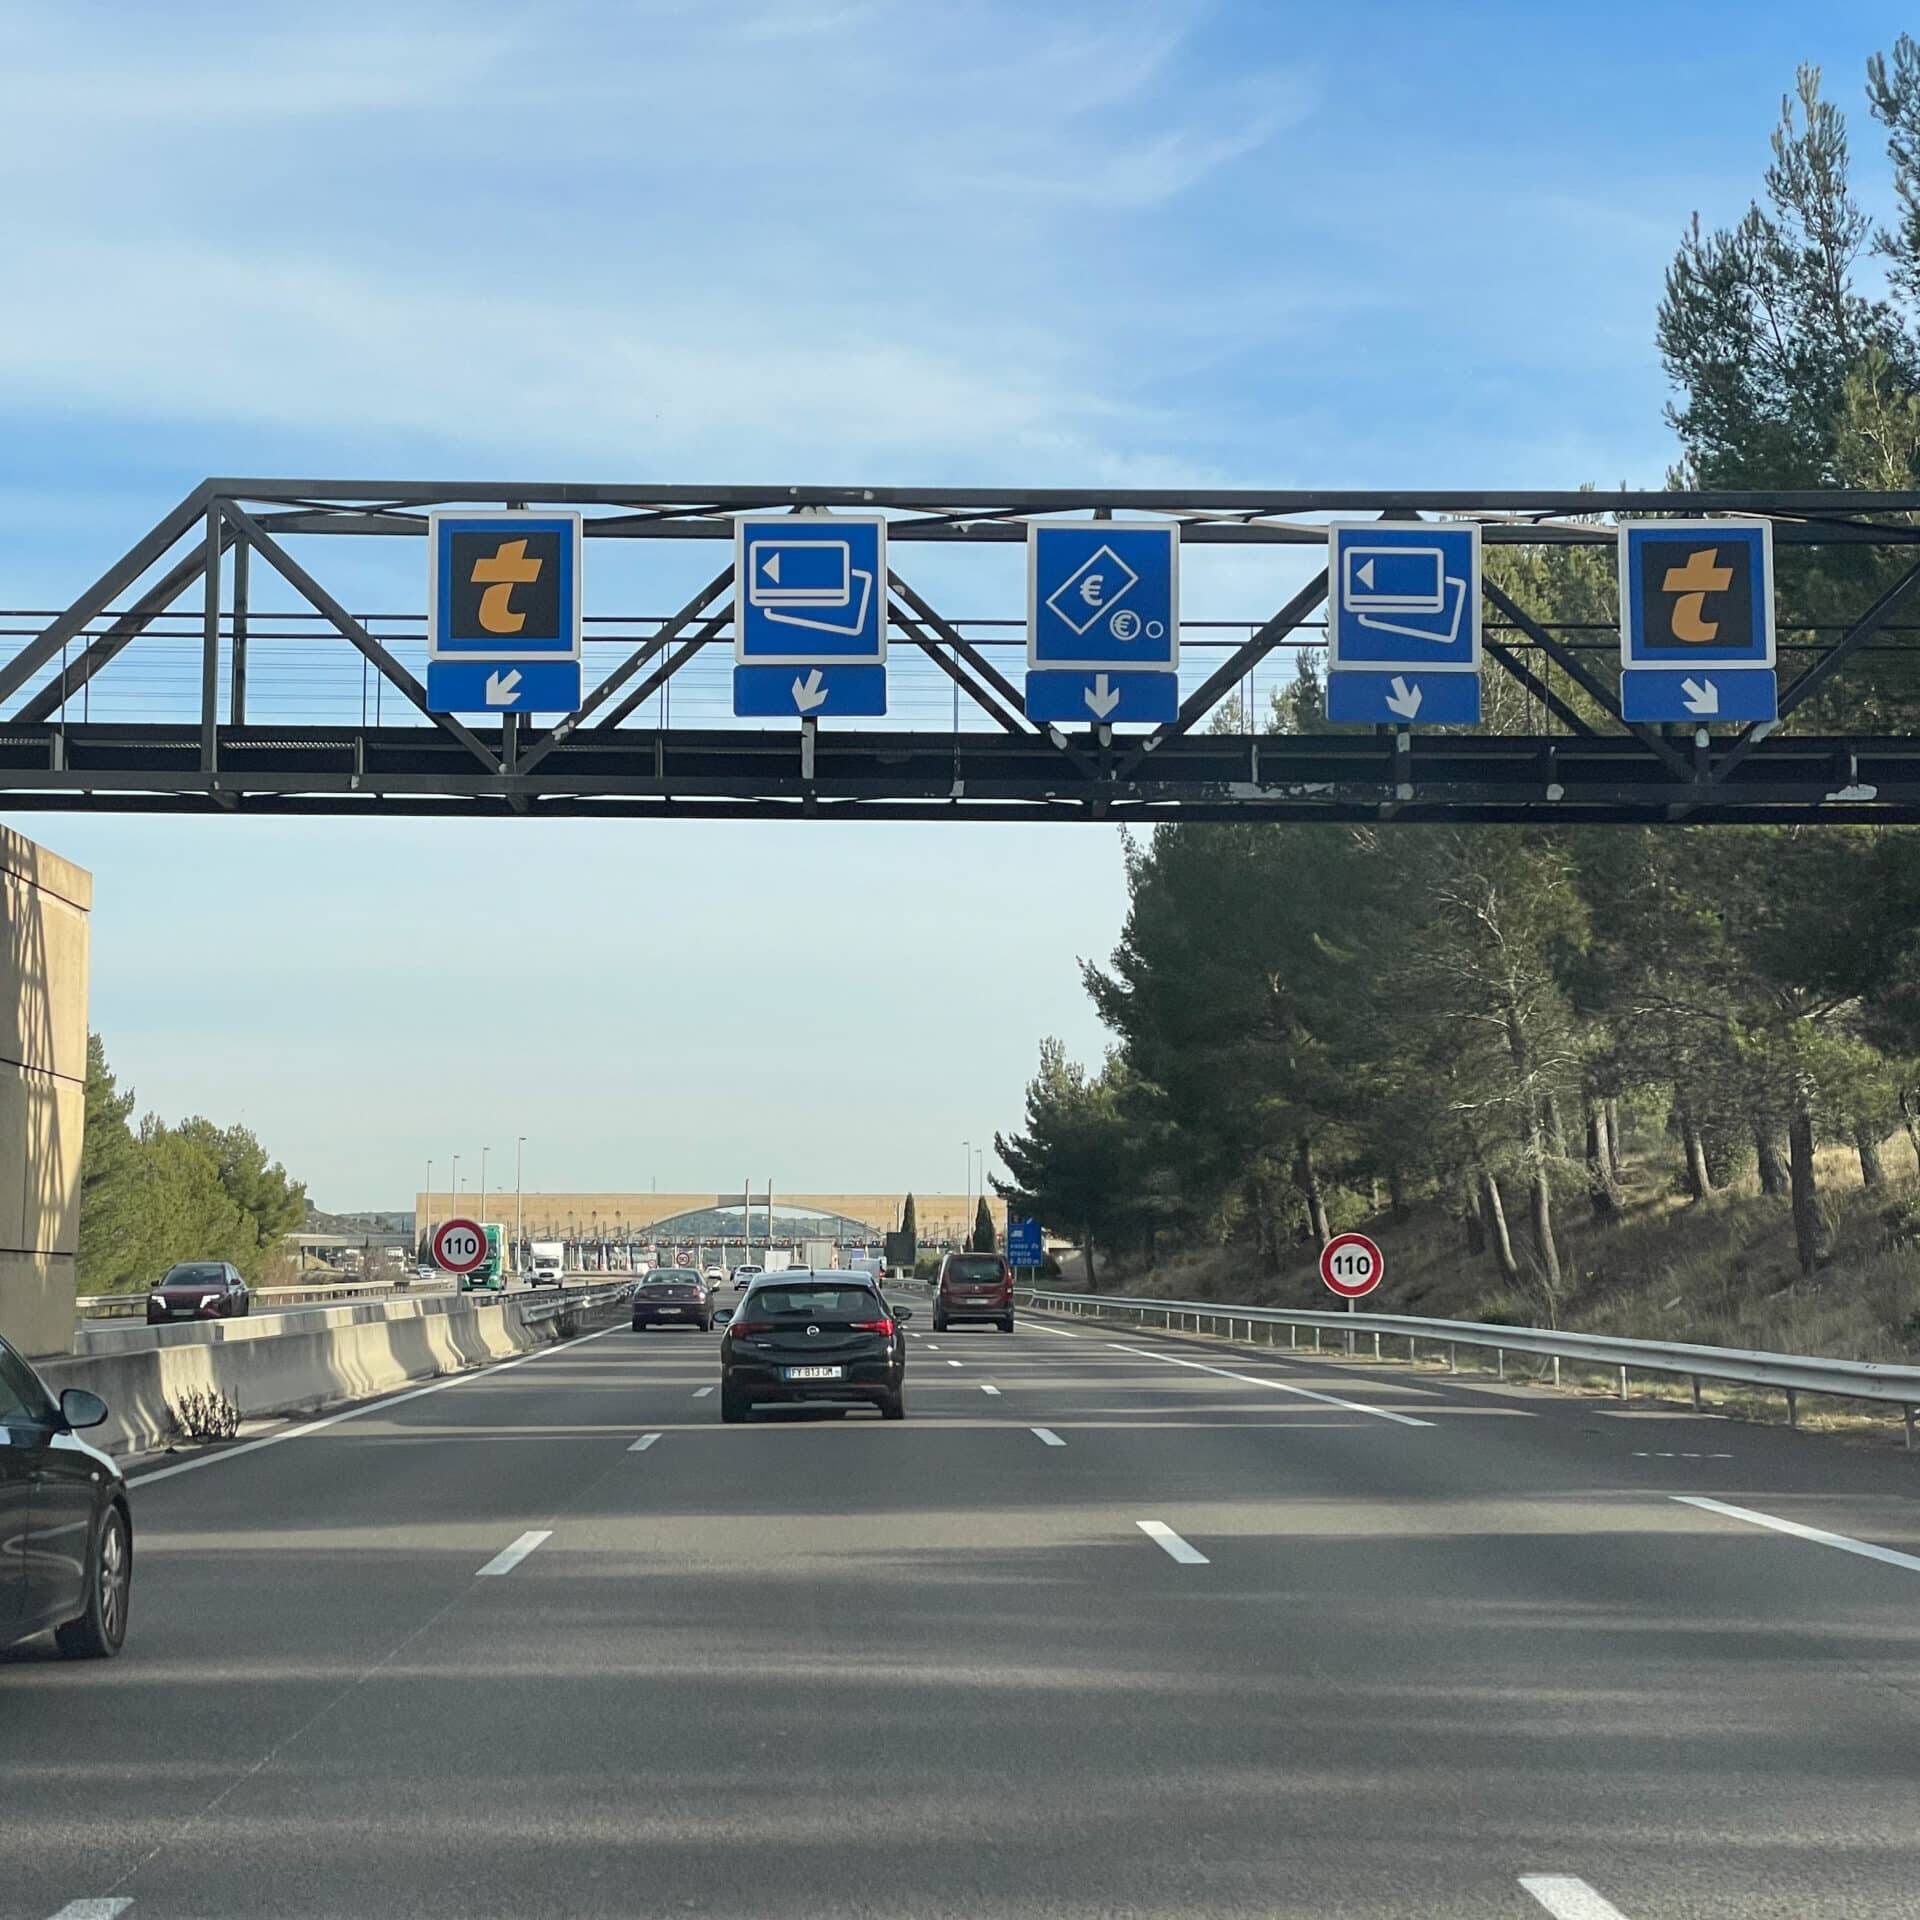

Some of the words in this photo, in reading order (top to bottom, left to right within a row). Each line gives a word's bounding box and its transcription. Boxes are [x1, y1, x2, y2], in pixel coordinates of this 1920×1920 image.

[470, 539, 543, 632] t
[1662, 548, 1733, 642] t
[444, 1237, 477, 1255] 110
[1334, 1255, 1371, 1275] 110
